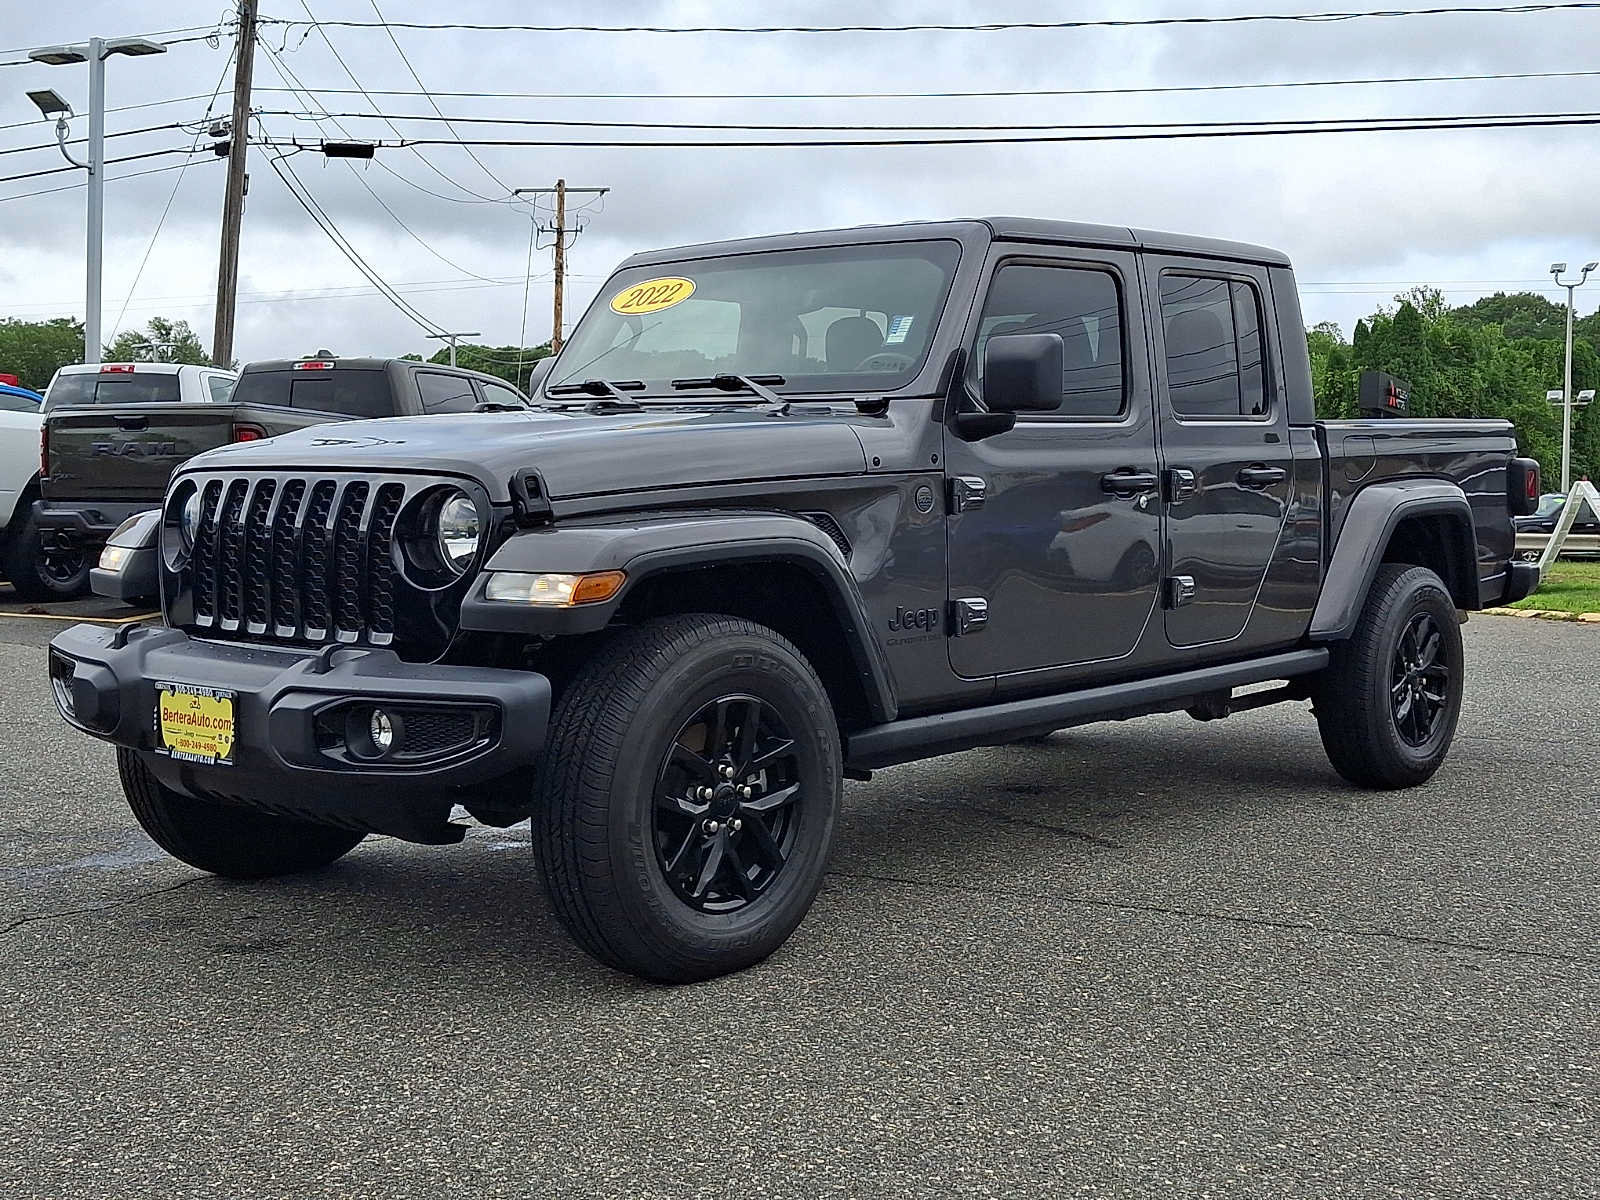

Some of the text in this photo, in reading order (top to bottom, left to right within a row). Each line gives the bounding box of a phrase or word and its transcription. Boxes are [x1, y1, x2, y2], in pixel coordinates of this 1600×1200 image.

[620, 283, 683, 308] 2022
[91, 441, 176, 456] RAM
[888, 605, 937, 632] Jeep
[162, 706, 232, 731] BerteraAuto.com
